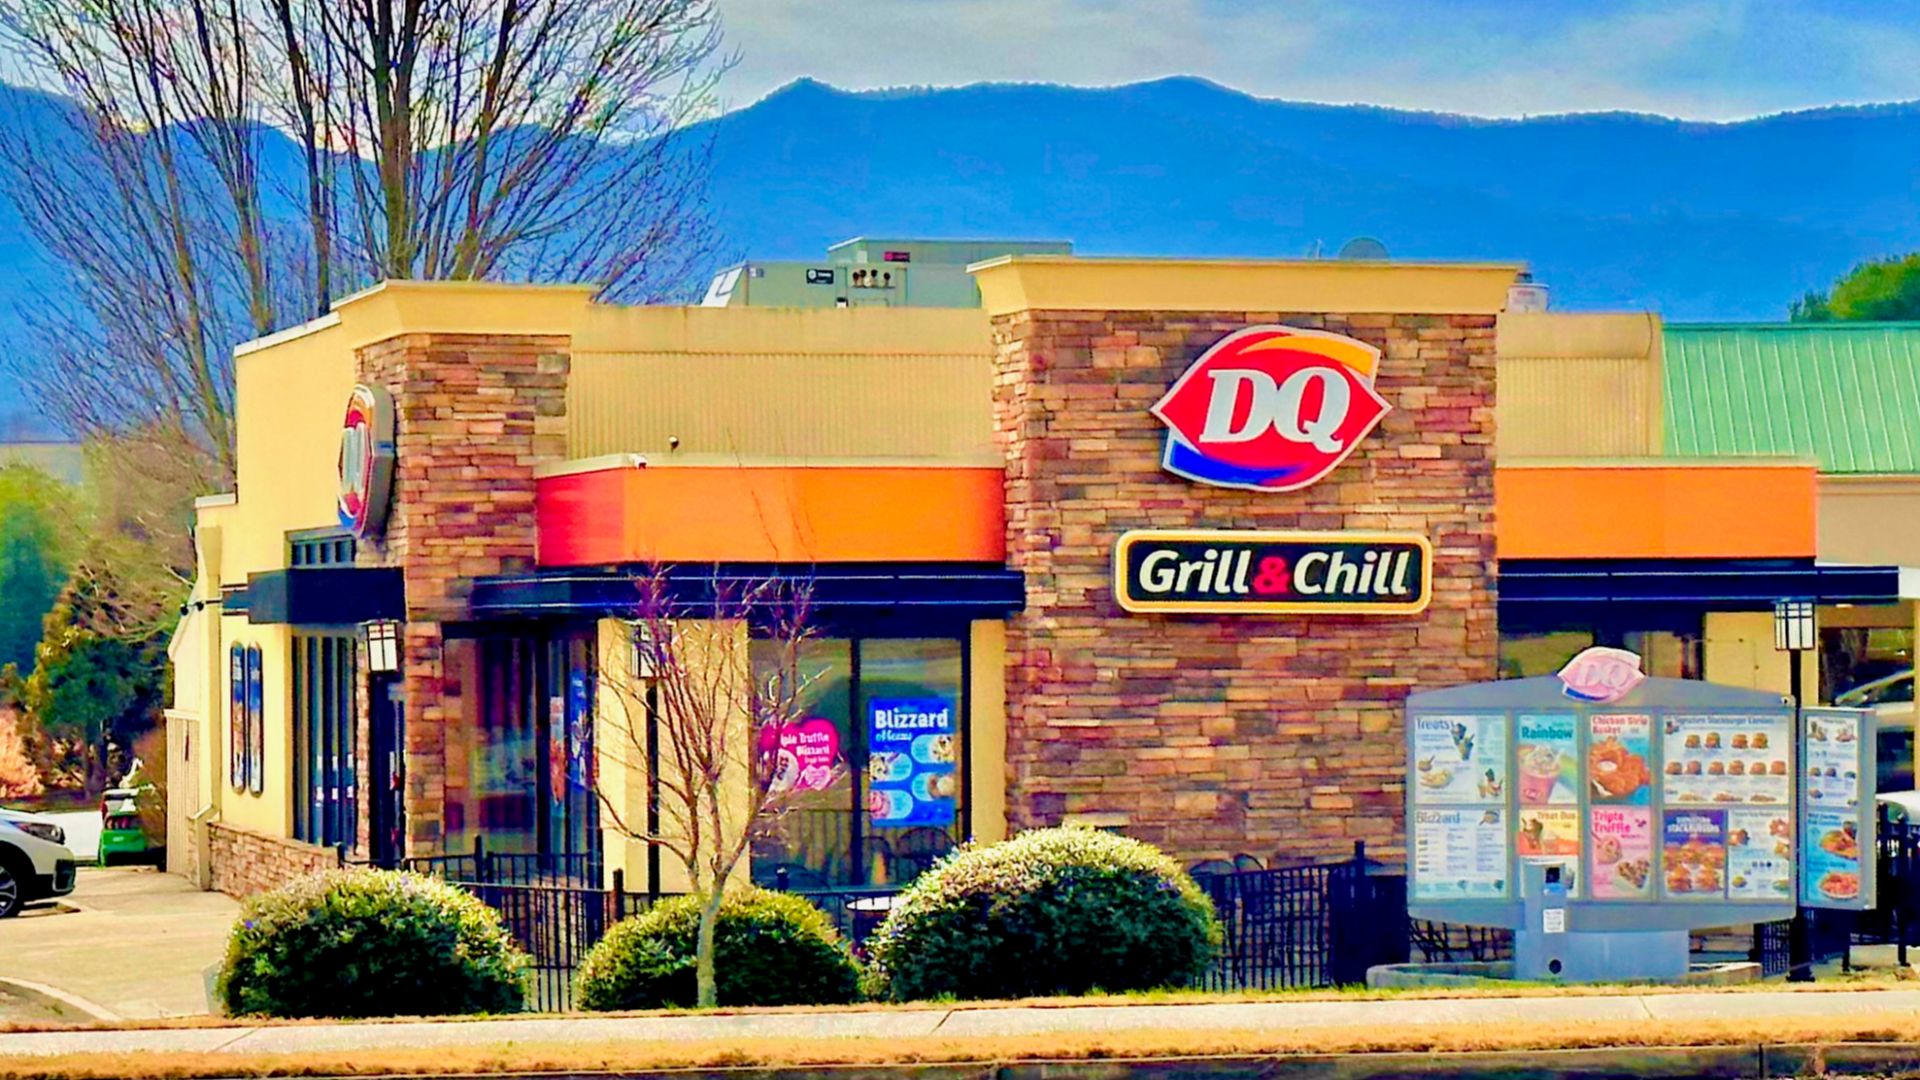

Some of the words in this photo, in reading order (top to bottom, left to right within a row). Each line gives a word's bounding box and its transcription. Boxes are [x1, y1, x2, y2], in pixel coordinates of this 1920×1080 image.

[1199, 366, 1351, 455] DQ
[1139, 549, 1252, 594] Grill
[1254, 555, 1290, 594] &
[1293, 550, 1410, 595] Chill
[874, 707, 949, 729] Blizzard
[1521, 724, 1574, 739] Rainbow
[1416, 811, 1460, 824] Blizzard
[1593, 823, 1631, 834] Truffle
